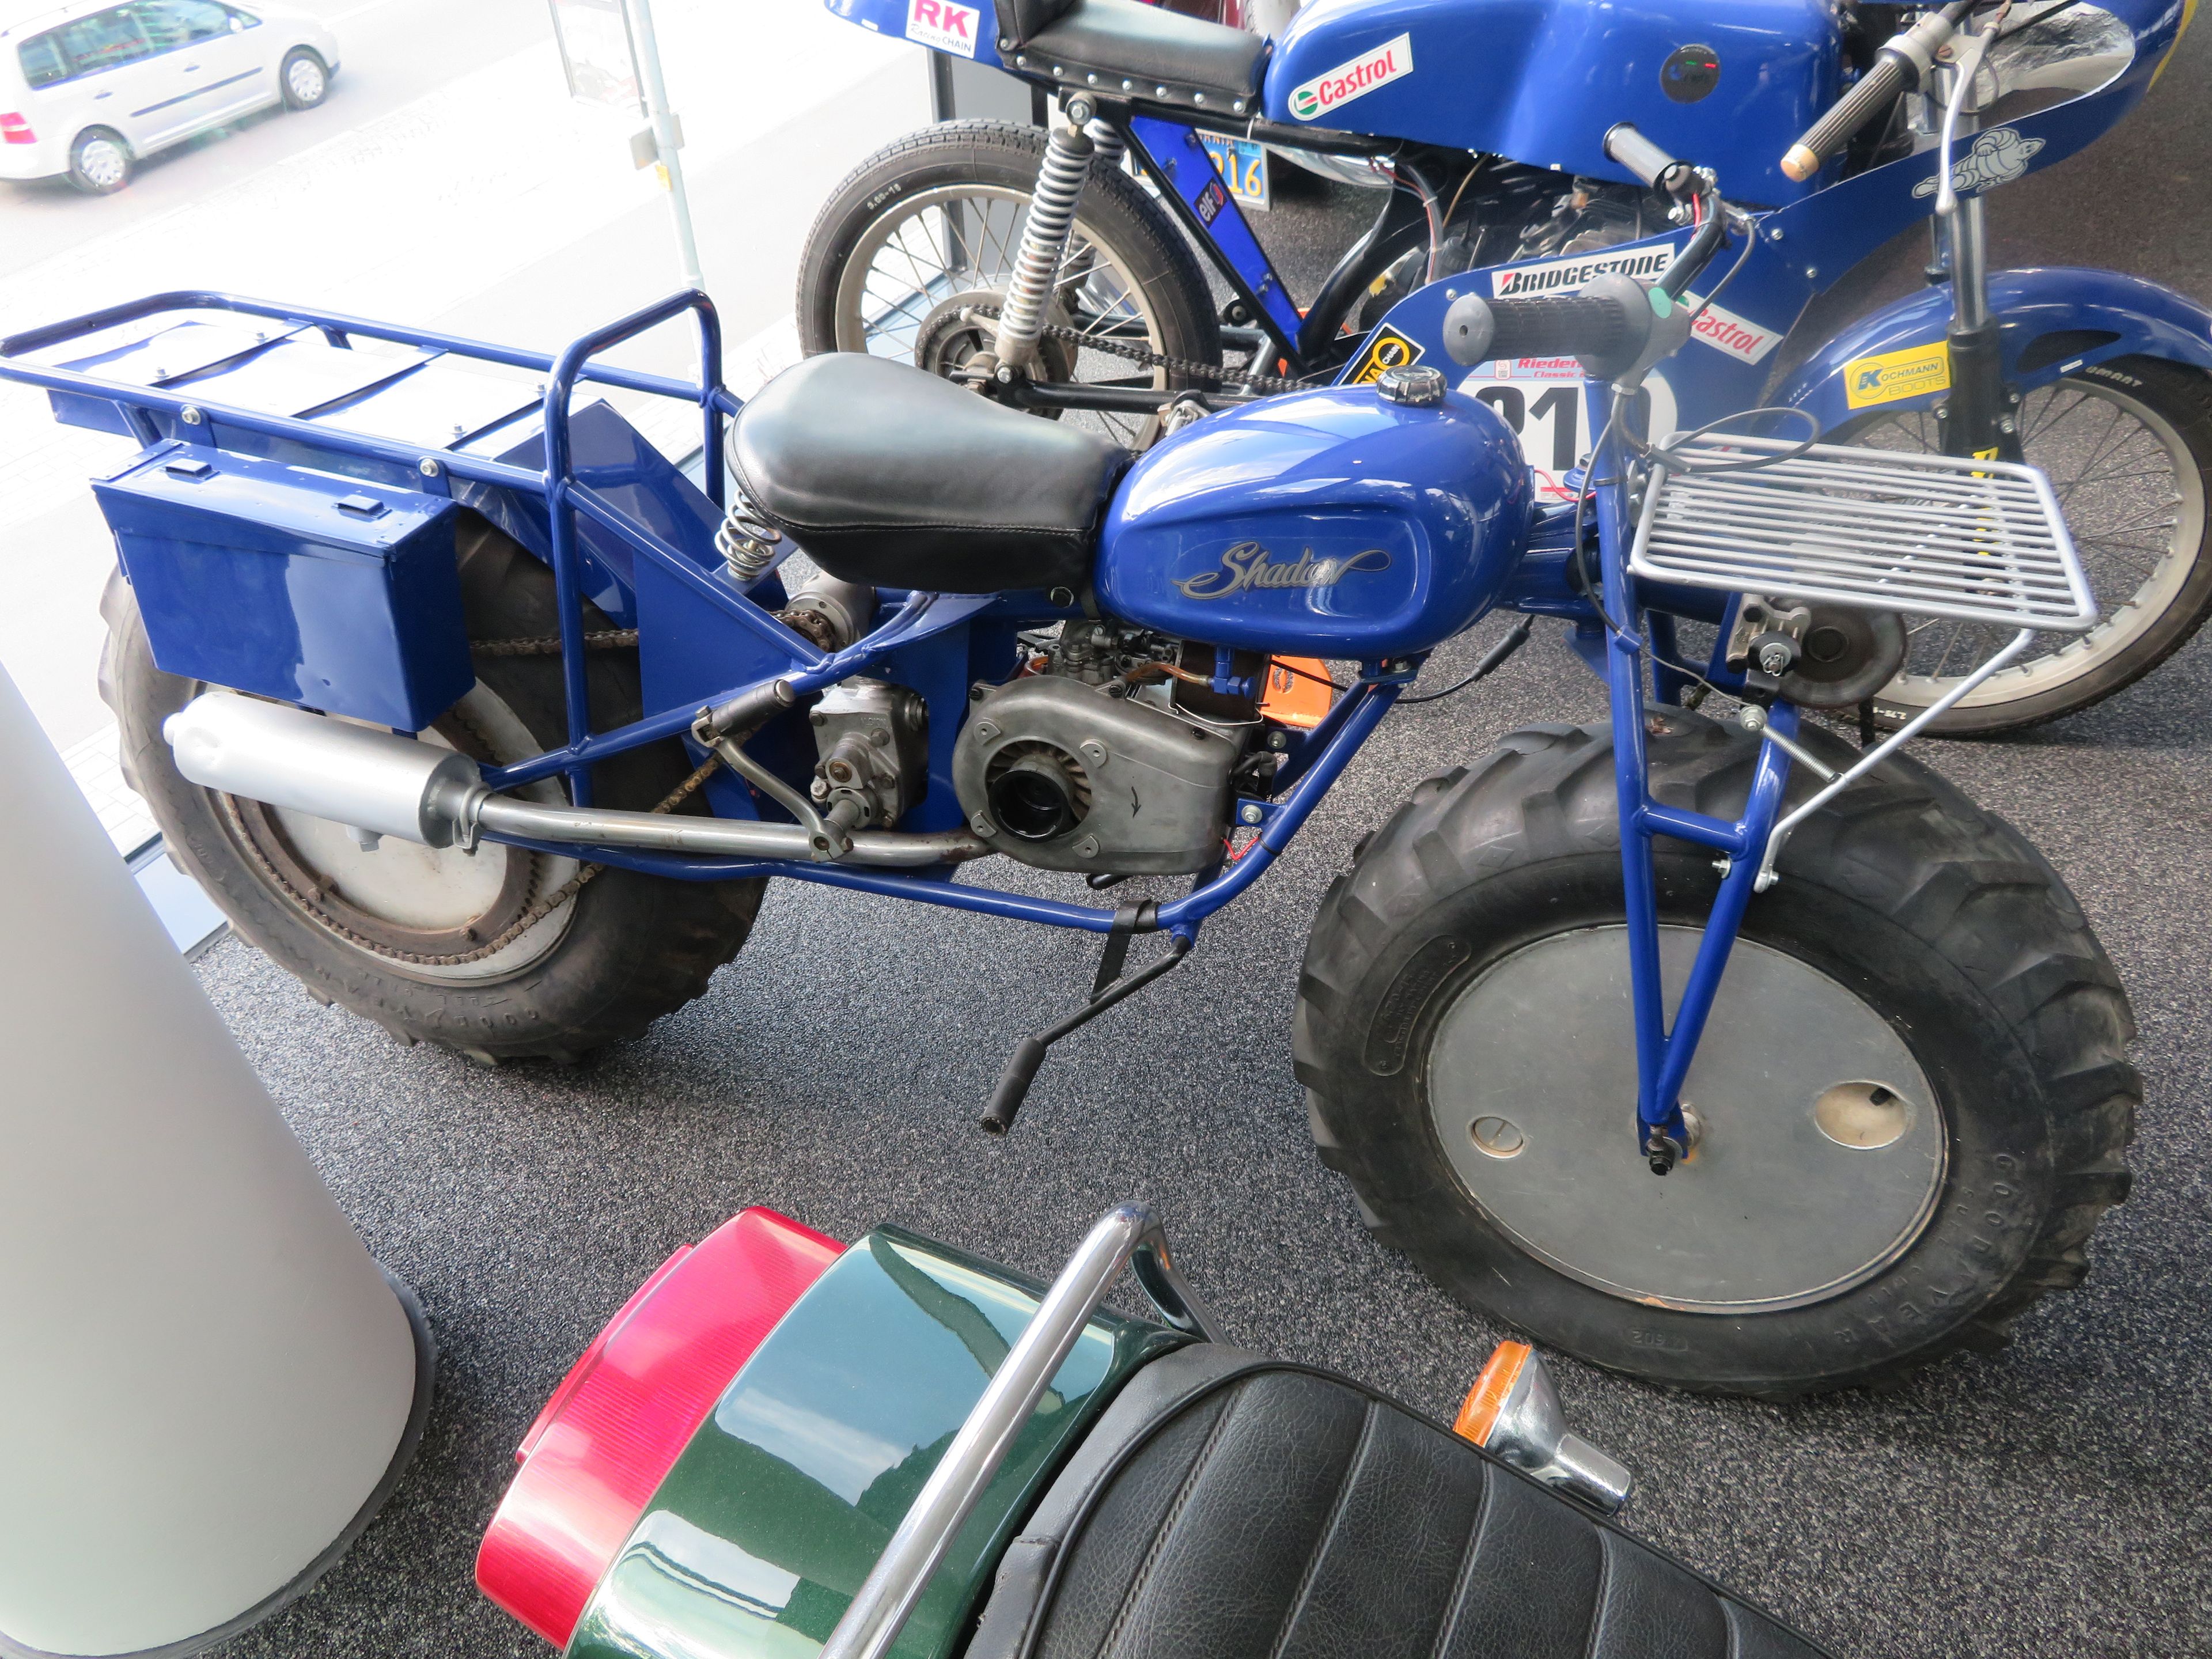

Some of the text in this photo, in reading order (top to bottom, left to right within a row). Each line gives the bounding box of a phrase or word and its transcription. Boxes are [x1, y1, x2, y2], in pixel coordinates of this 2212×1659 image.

[914, 0, 971, 38] RK
[942, 36, 971, 52] CHAIN
[1319, 50, 1397, 105] Castrol
[1382, 344, 1401, 365] CHAIN
[1533, 370, 1575, 378] Classic
[1858, 363, 1939, 390] KOCHMANN
[1888, 376, 1946, 396] BOOTS
[1171, 541, 1392, 600] Shadow
